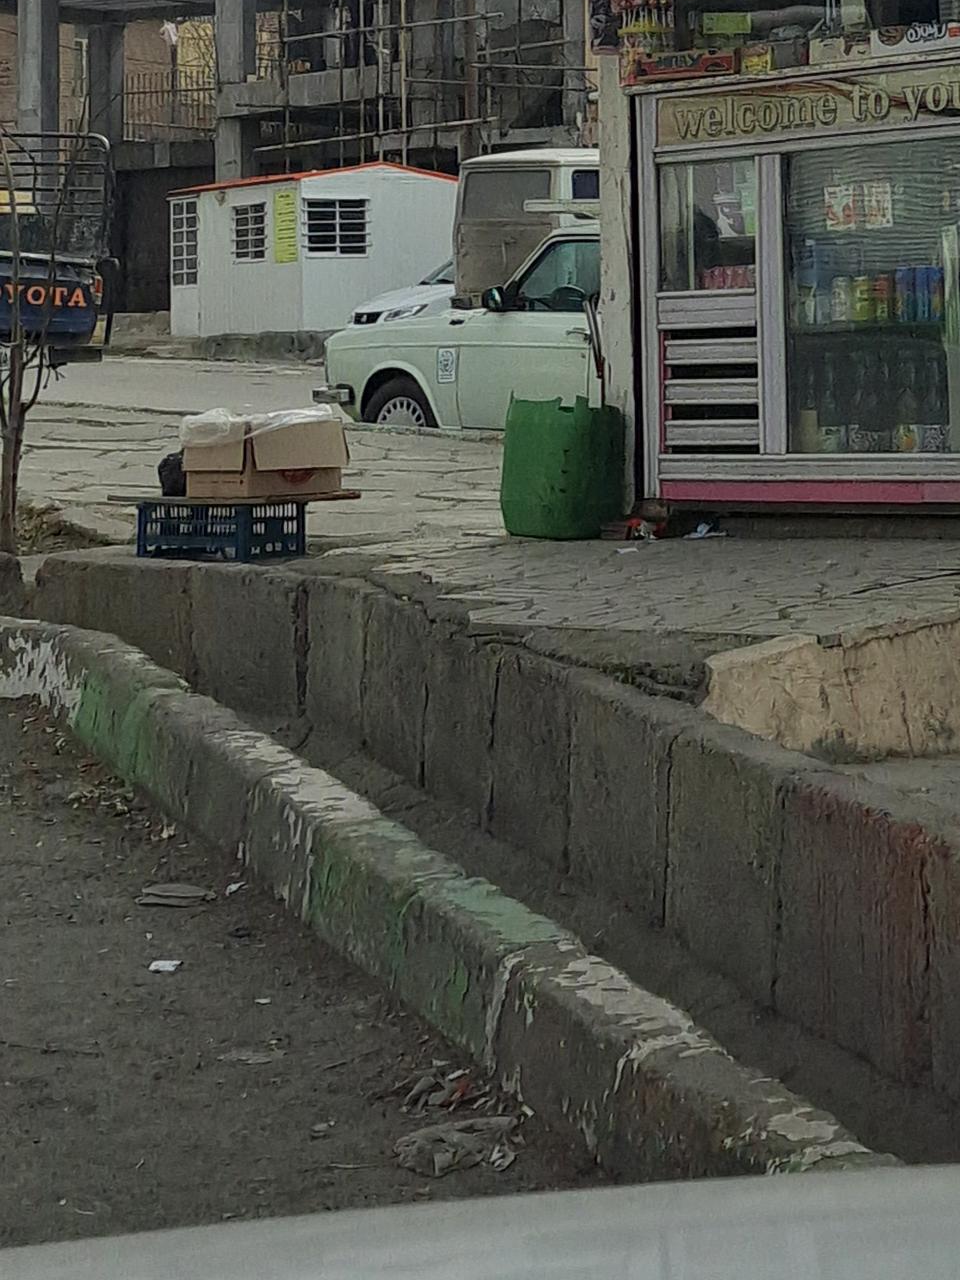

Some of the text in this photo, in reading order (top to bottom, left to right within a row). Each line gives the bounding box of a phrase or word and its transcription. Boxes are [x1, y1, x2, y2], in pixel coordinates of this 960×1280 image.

[674, 94, 838, 139] welcome
[849, 81, 891, 121] to
[0, 282, 87, 308] YOTA
